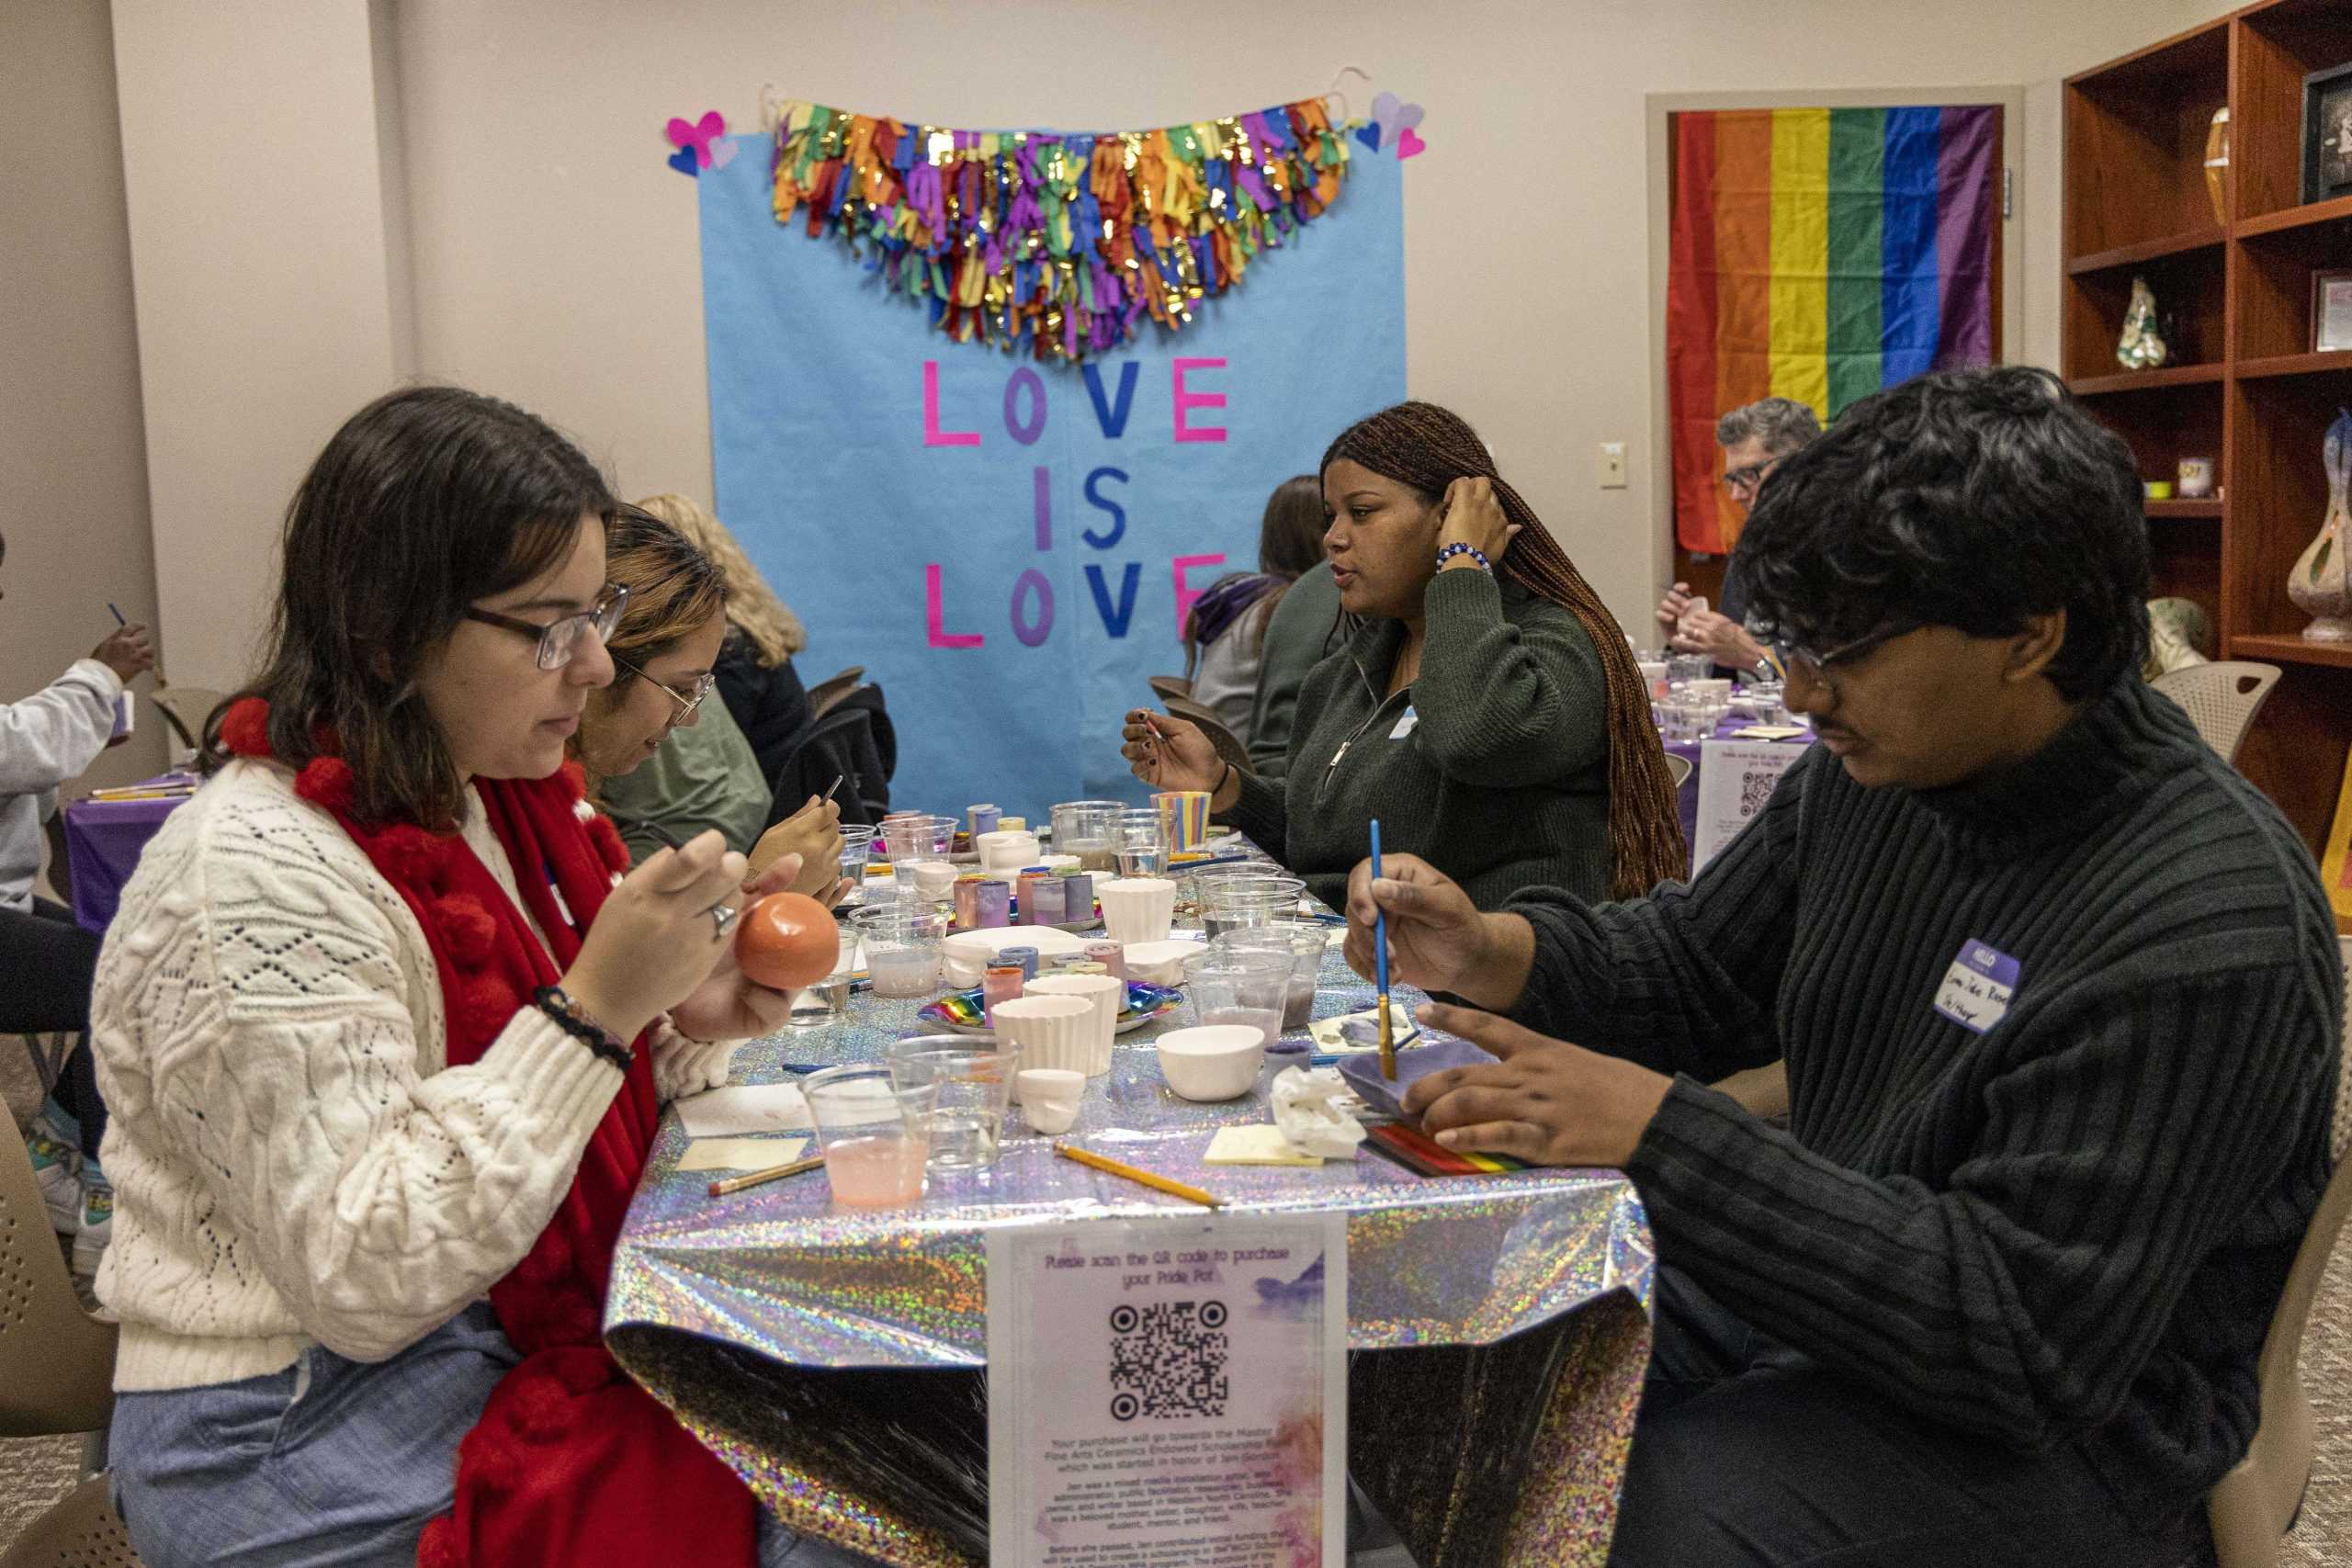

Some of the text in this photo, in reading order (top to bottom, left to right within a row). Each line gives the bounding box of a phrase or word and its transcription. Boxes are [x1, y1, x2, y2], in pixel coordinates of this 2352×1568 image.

[922, 357, 1227, 446] LOVE
[1033, 467, 1130, 551] IS
[1045, 1246, 1290, 1269] Please scan the QR code to purchase
[1122, 1269, 1214, 1291] your Pride Pot
[1078, 1437, 1128, 1449] purchase
[1131, 1432, 1149, 1442] will
[1152, 1433, 1166, 1444] go
[1169, 1430, 1212, 1441] towards
[1215, 1429, 1233, 1439] the
[1236, 1427, 1273, 1437] Master
[1070, 1450, 1093, 1460] Arts
[1096, 1447, 1147, 1458] Ceramics
[1148, 1443, 1199, 1454] Endowed
[1201, 1440, 1263, 1451] Scholarship
[1057, 1462, 1089, 1472] which
[1092, 1462, 1114, 1471] was
[1116, 1458, 1155, 1469] started
[1158, 1457, 1169, 1466] in
[1170, 1456, 1202, 1465] honor
[1204, 1453, 1217, 1464] of
